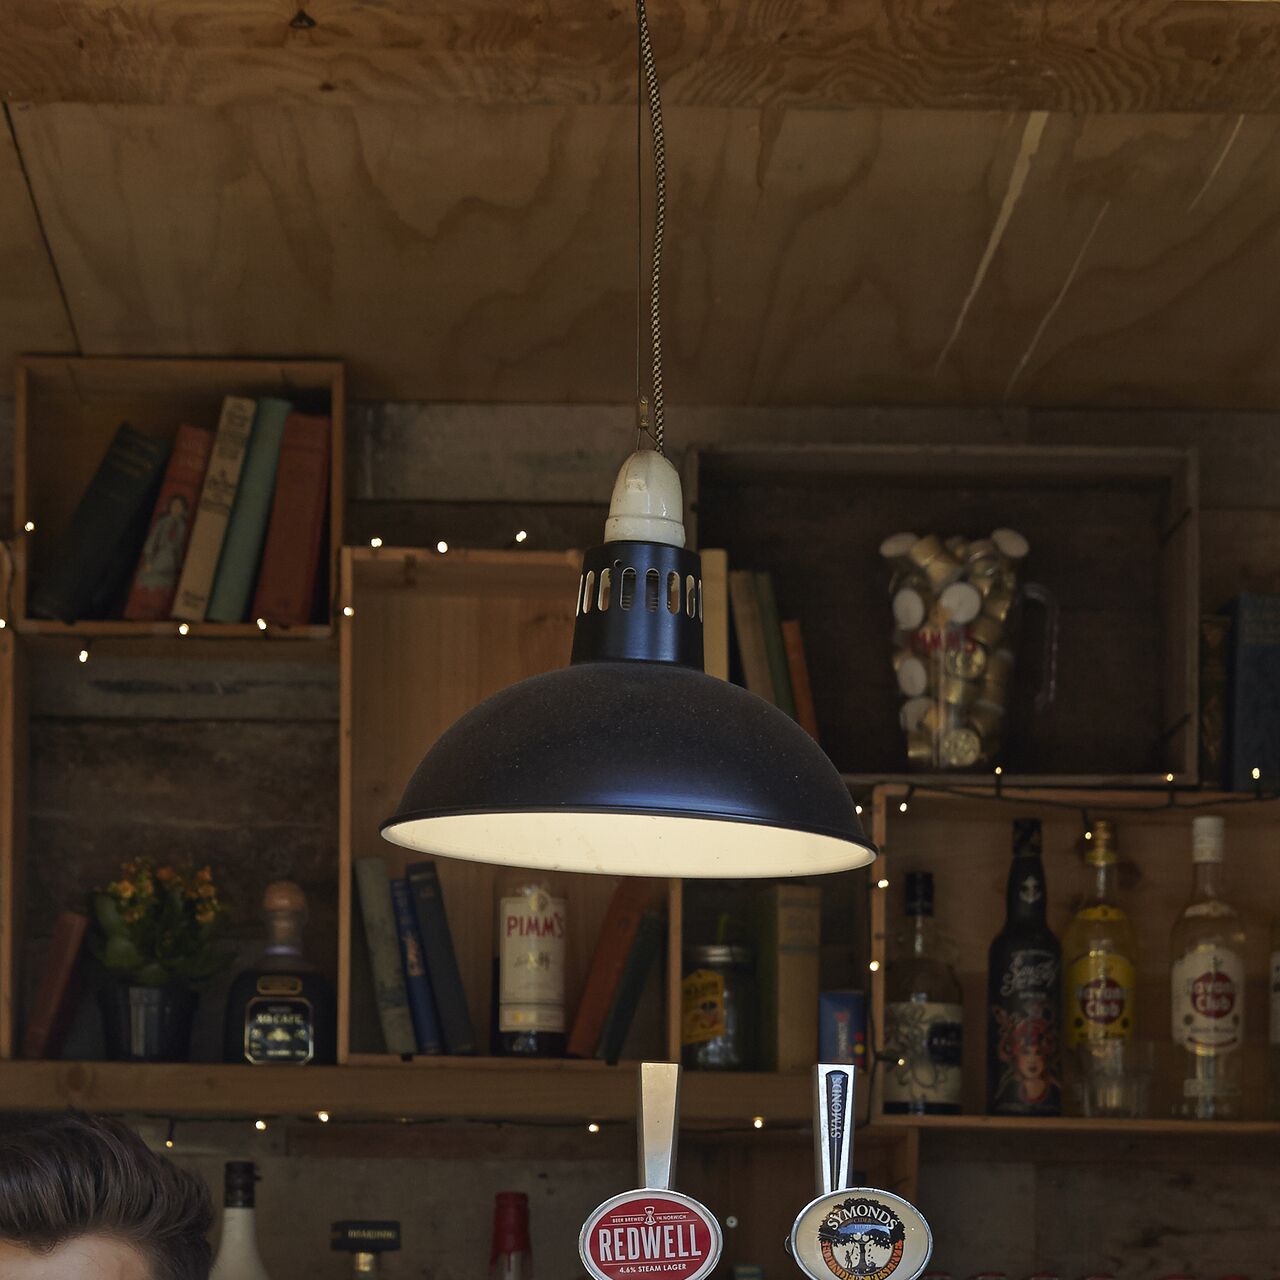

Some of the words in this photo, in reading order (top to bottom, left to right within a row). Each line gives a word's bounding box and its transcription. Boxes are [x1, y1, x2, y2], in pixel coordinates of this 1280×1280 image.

[827, 1204, 898, 1231] SYMONDS
[599, 1223, 702, 1262] REDWELL
[619, 1265, 636, 1274] 4.6%
[638, 1264, 661, 1273] STEAM
[663, 1263, 687, 1271] LAGER
